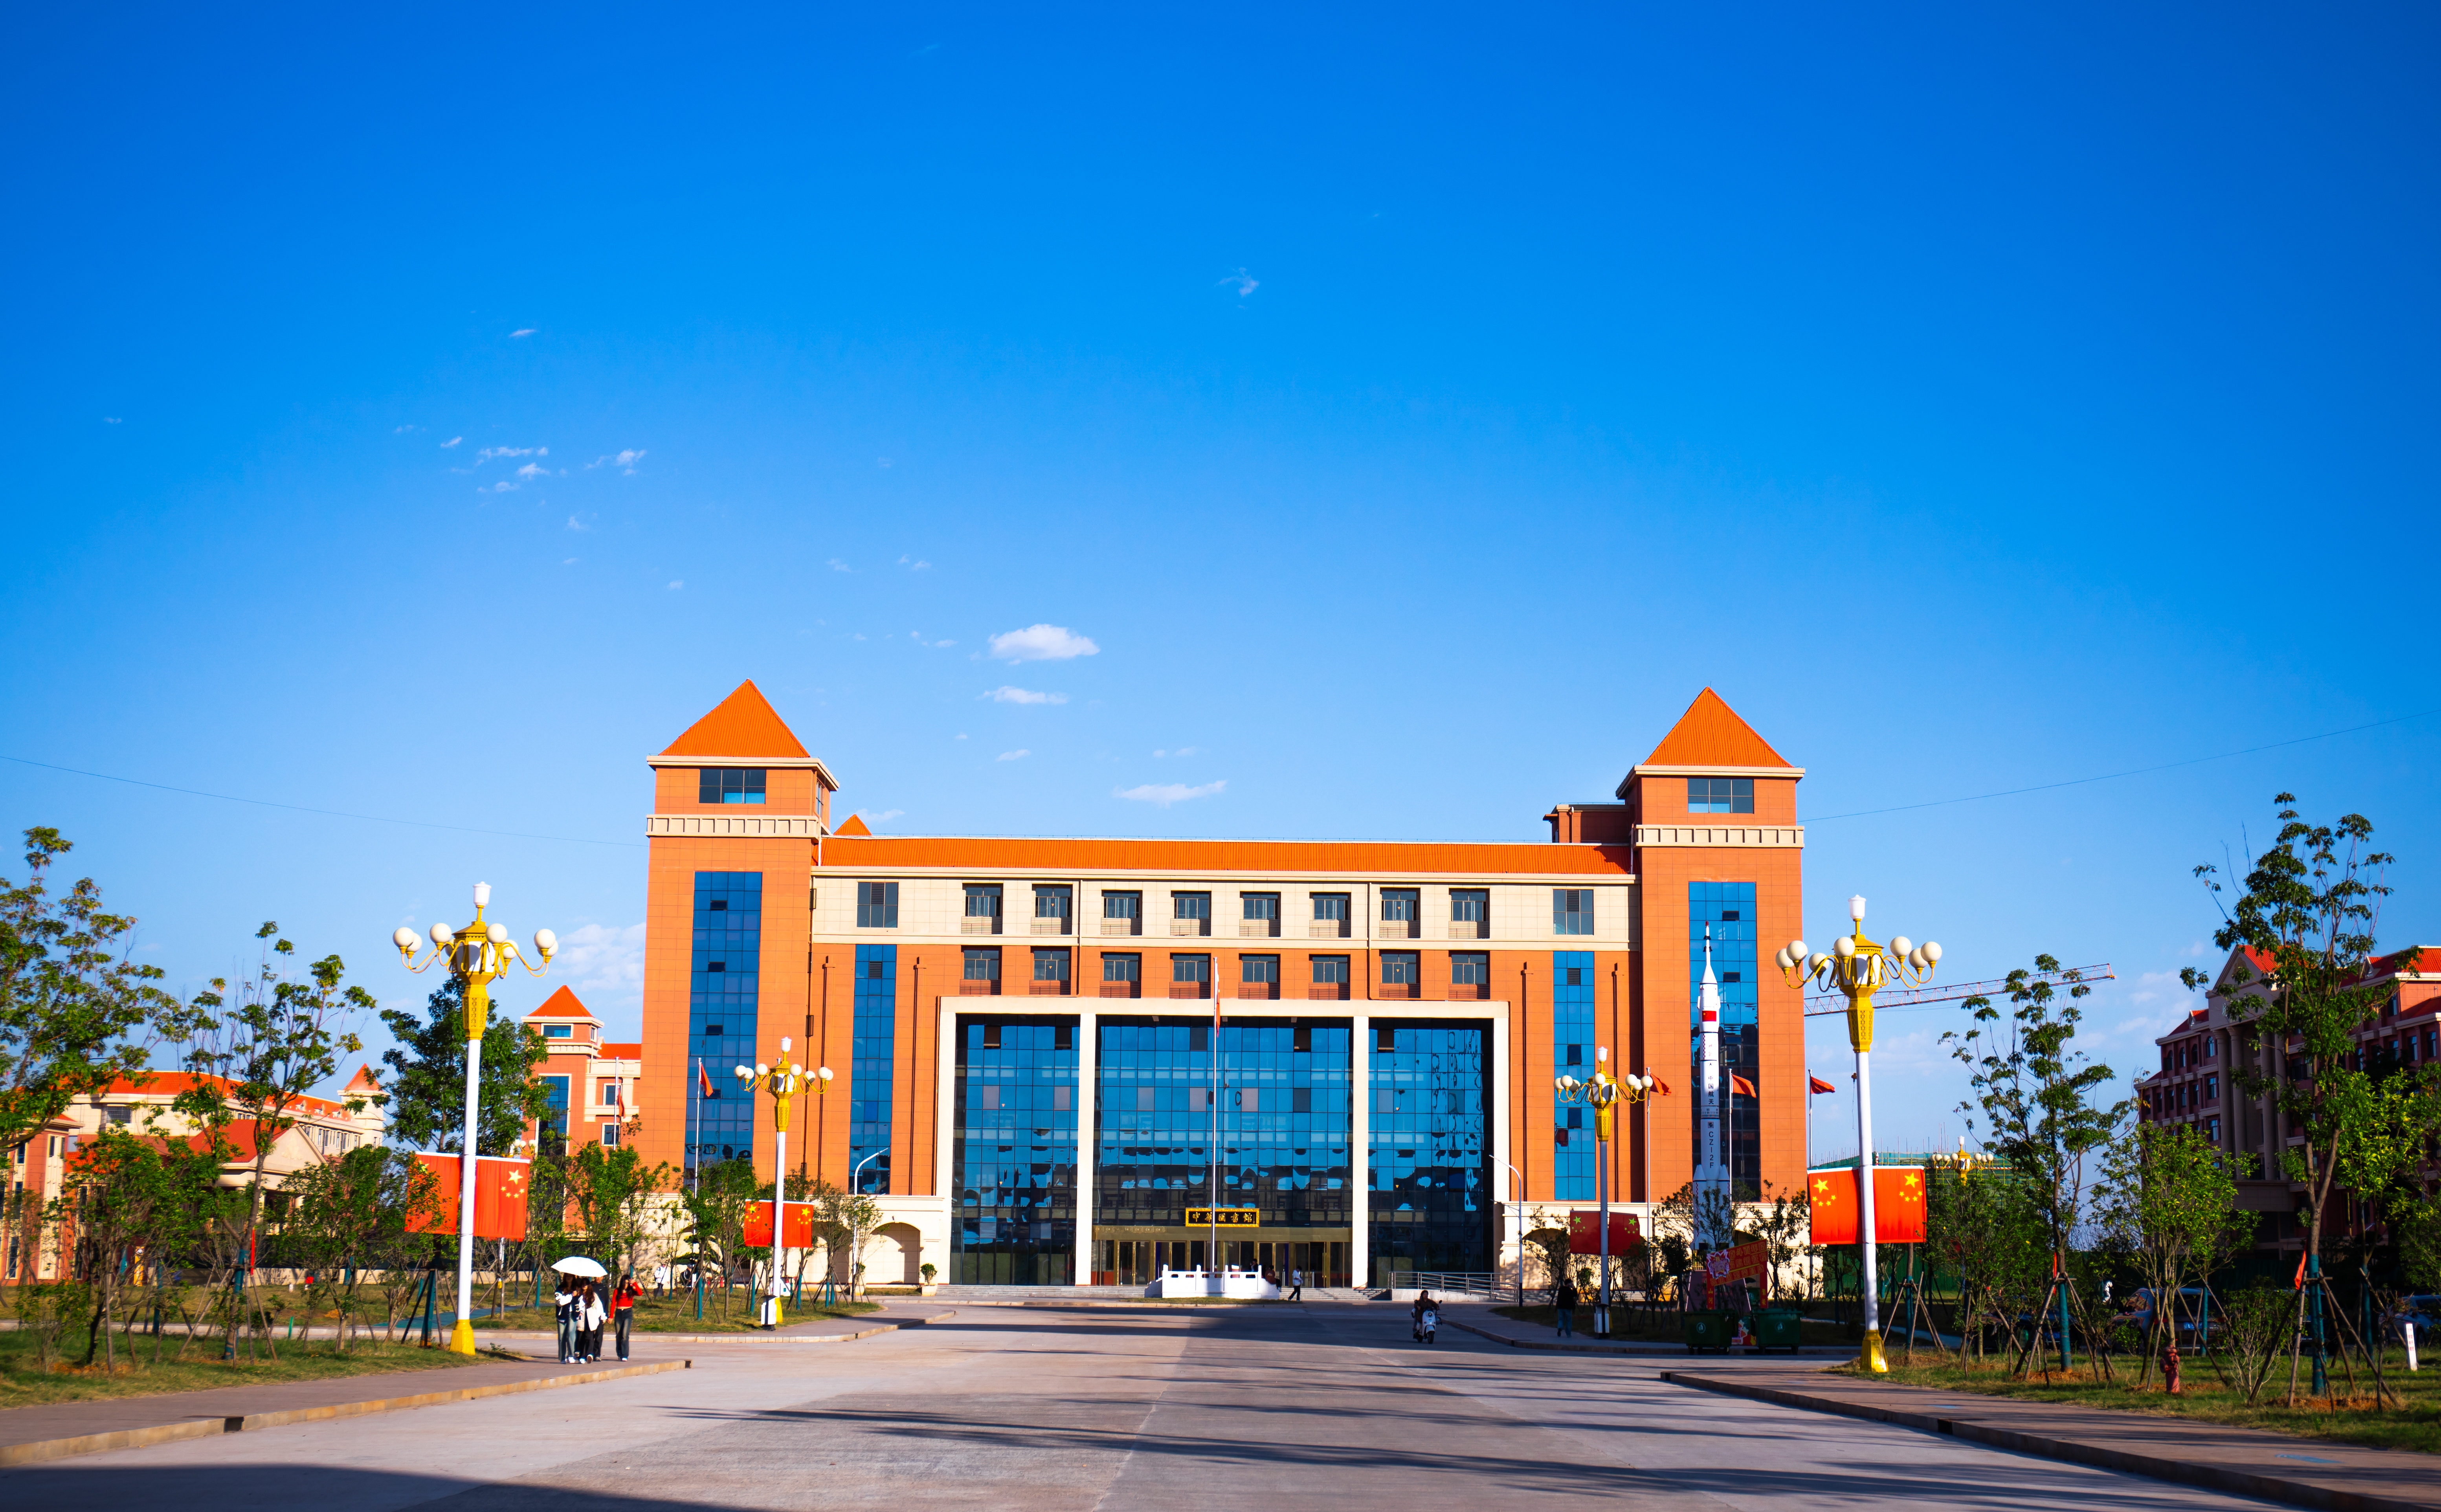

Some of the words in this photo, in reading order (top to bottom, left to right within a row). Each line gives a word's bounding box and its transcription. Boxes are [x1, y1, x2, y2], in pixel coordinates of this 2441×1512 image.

[1728, 1242, 1766, 1259] 奋斗百年路
